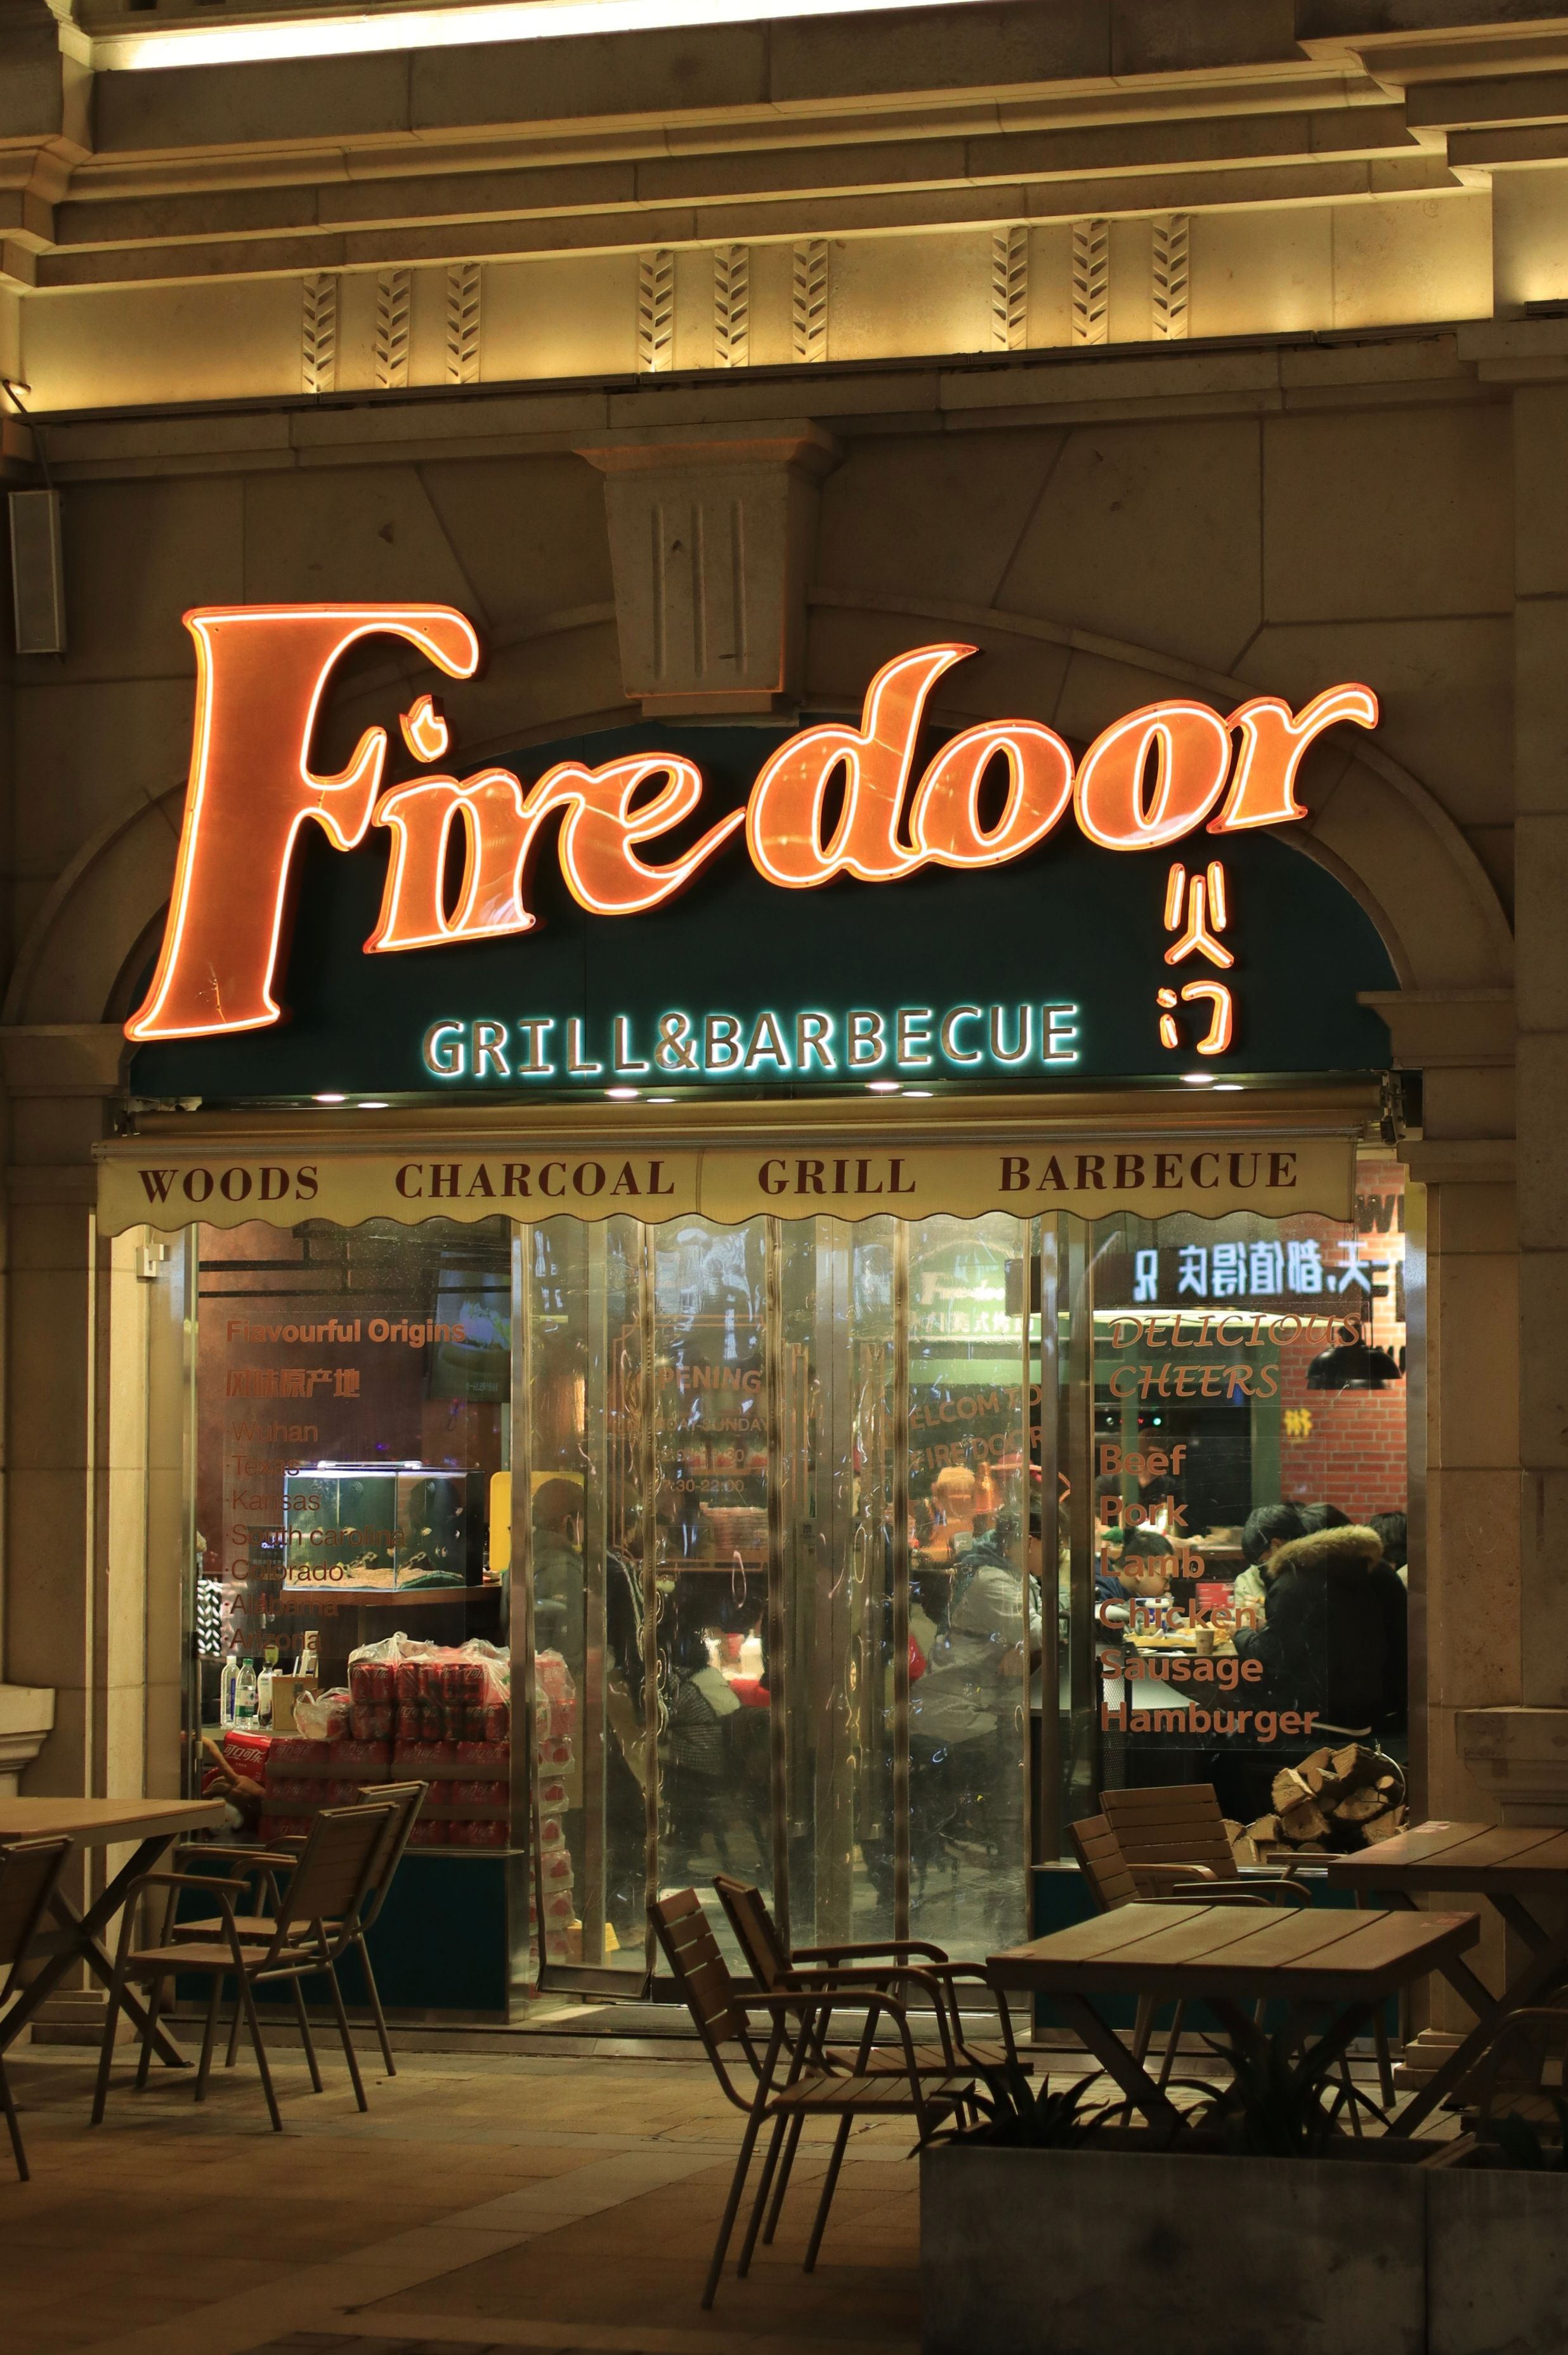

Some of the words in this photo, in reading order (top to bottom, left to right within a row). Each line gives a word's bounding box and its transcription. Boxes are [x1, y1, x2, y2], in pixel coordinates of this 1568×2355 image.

[138, 1165, 319, 1204] WOODS
[395, 1160, 676, 1199] CHARCOAL
[758, 1158, 917, 1195] GRILL
[998, 1151, 1298, 1191] BARBECUE
[369, 1318, 466, 1348] Origins
[1107, 1312, 1361, 1349] DELICIOUS
[226, 1368, 360, 1398] 风味原产地
[636, 1365, 762, 1394] PENING
[1109, 1363, 1279, 1400] CHEERS
[232, 1420, 318, 1443] Wuhan
[232, 1455, 301, 1477] Texas
[1100, 1444, 1187, 1476] Beef
[232, 1490, 321, 1511] Kansas
[1100, 1495, 1189, 1526] Pork
[232, 1524, 303, 1547] South
[310, 1524, 407, 1547] carolina
[230, 1558, 344, 1582] Colorado
[1101, 1546, 1205, 1578] Lamb
[230, 1593, 339, 1617] Alabama
[1099, 1597, 1257, 1630] Chicken
[230, 1628, 323, 1651] Arizona
[1100, 1650, 1263, 1691] Sausage
[1101, 1701, 1320, 1742] Hamburger
[223, 1743, 266, 1764] 可口可乐
